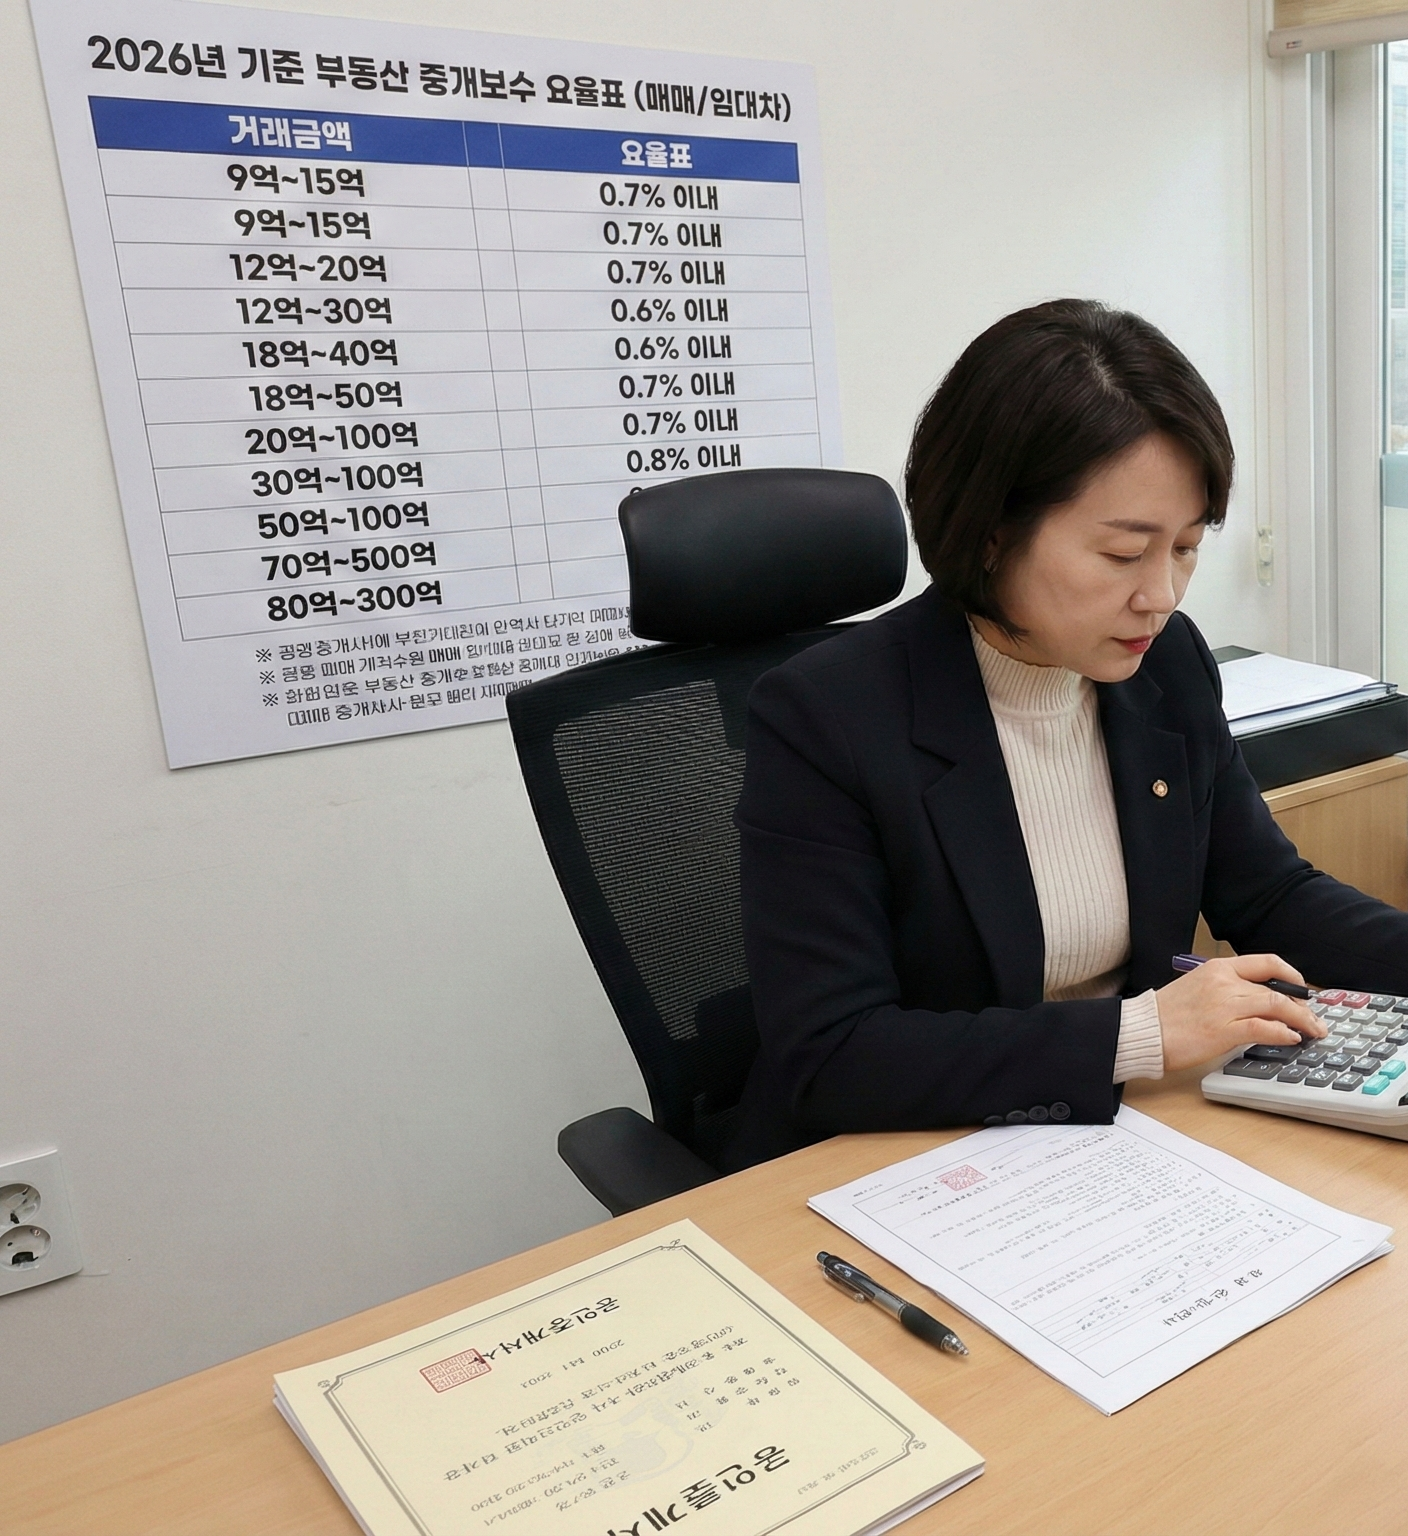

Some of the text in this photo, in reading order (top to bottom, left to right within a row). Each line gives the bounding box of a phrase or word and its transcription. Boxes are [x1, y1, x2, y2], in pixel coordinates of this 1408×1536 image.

[87, 35, 791, 123] 2026년 기준 부동산 중개보수 요율표 (매매/임대차)
[228, 115, 353, 152] 거래금액
[621, 139, 693, 169] 요율표
[226, 163, 365, 198] 9억~15억
[599, 181, 719, 211] 0.7% 이내
[234, 209, 372, 240] 9억~15억
[603, 220, 722, 248] 0.7% 이내
[229, 253, 387, 283] 12억~20억
[607, 259, 726, 286] 0.7% 이내
[235, 297, 393, 325] 12억~30억
[611, 298, 729, 323] 0.6% 이내
[241, 338, 399, 368] 18억~40억
[614, 334, 732, 361] 0.6% 이내
[248, 381, 403, 412] 18억~50억
[618, 371, 735, 399] 0.7% 이내
[622, 407, 739, 436] 0.7% 이내
[244, 421, 419, 455] 20억~100억
[626, 443, 742, 473] 0.8% 이내
[251, 461, 424, 497] 30억~100억
[257, 501, 430, 540] 50억~100억
[260, 541, 437, 581] 70억~500억
[267, 580, 443, 622] 80억~300억
